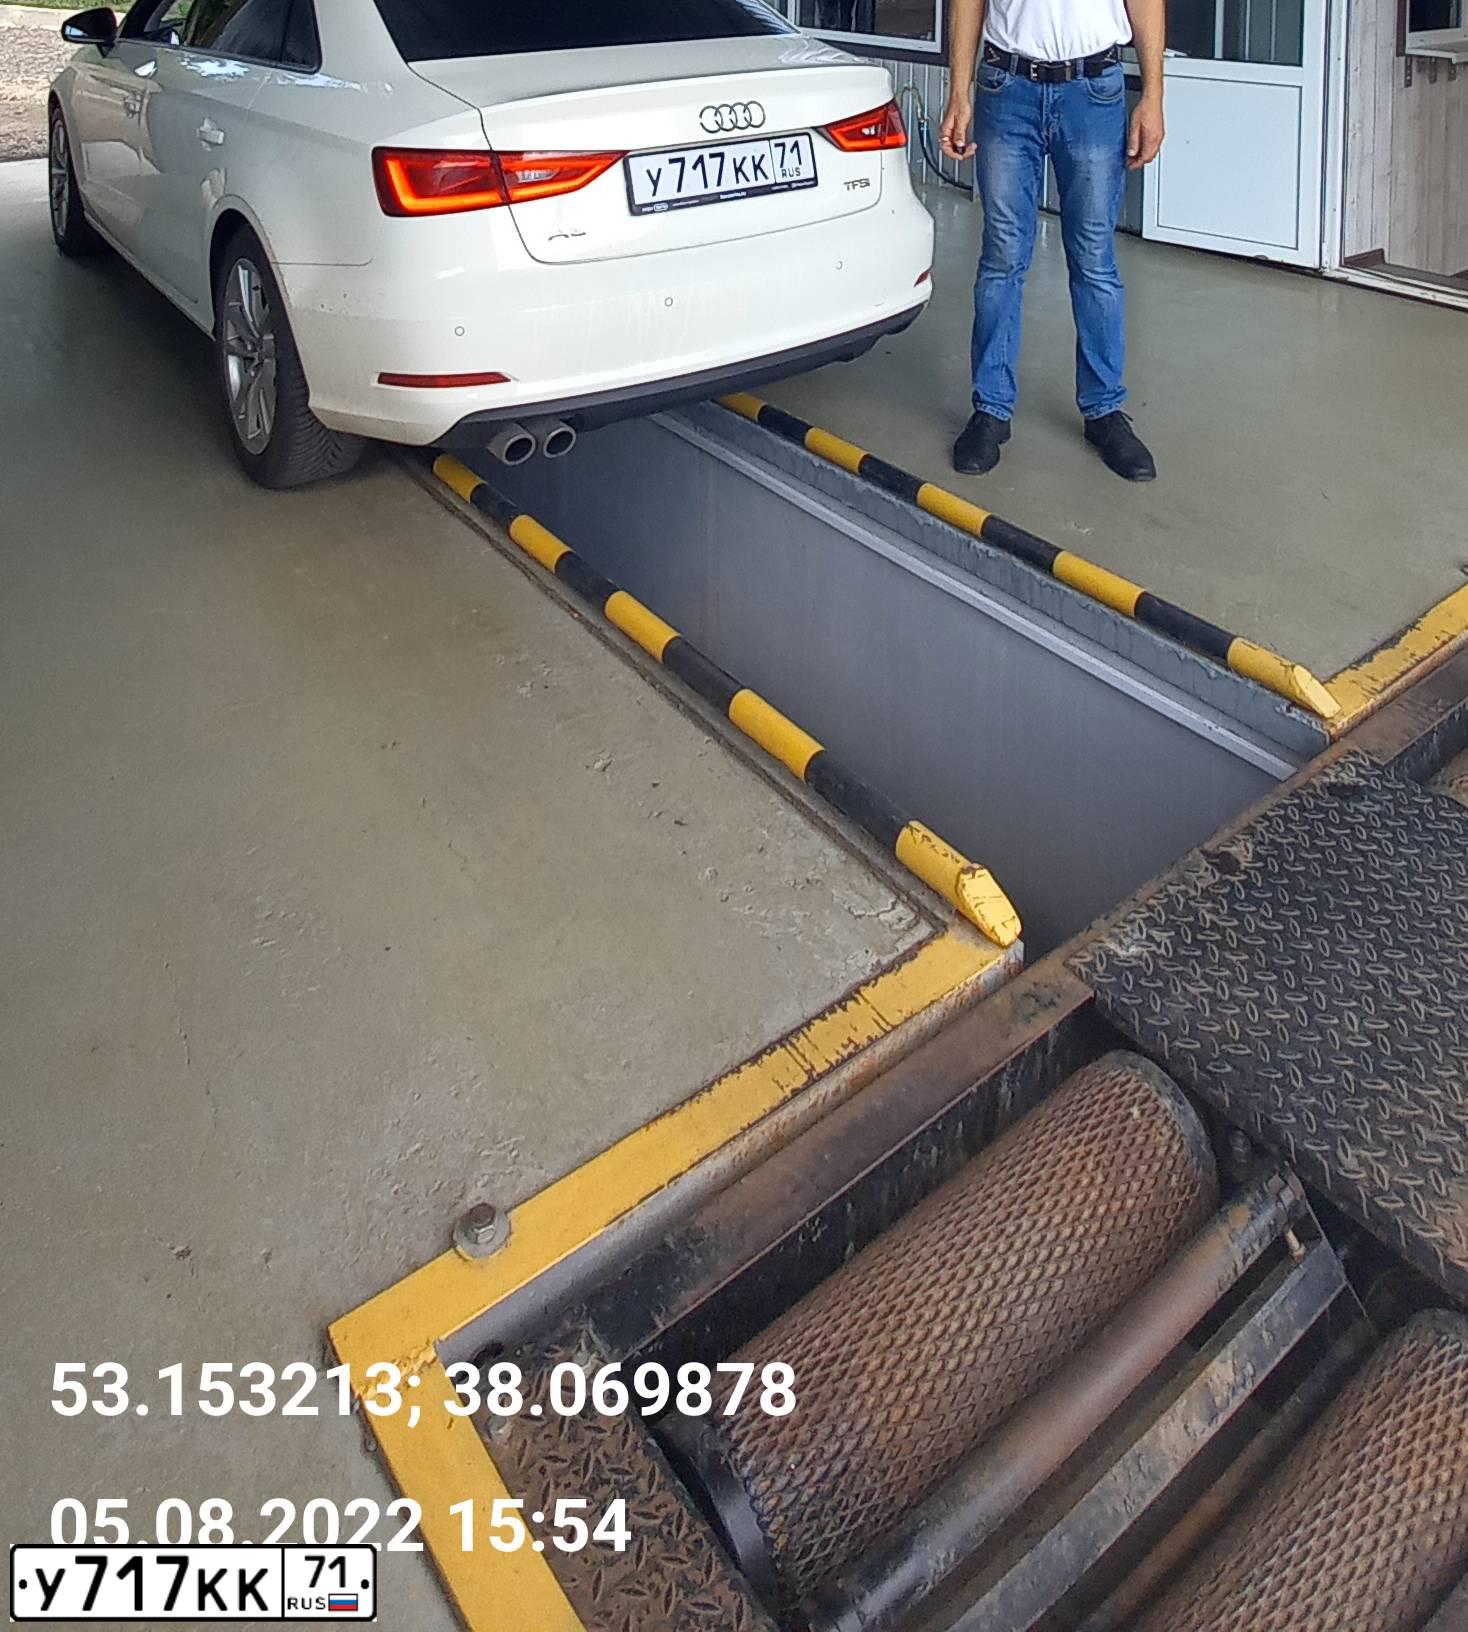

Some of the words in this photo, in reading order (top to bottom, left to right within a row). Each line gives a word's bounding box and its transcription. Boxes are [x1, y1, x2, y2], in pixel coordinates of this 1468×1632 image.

[774, 140, 802, 169] 71
[646, 151, 769, 197] У717КК
[781, 167, 801, 179] RUS
